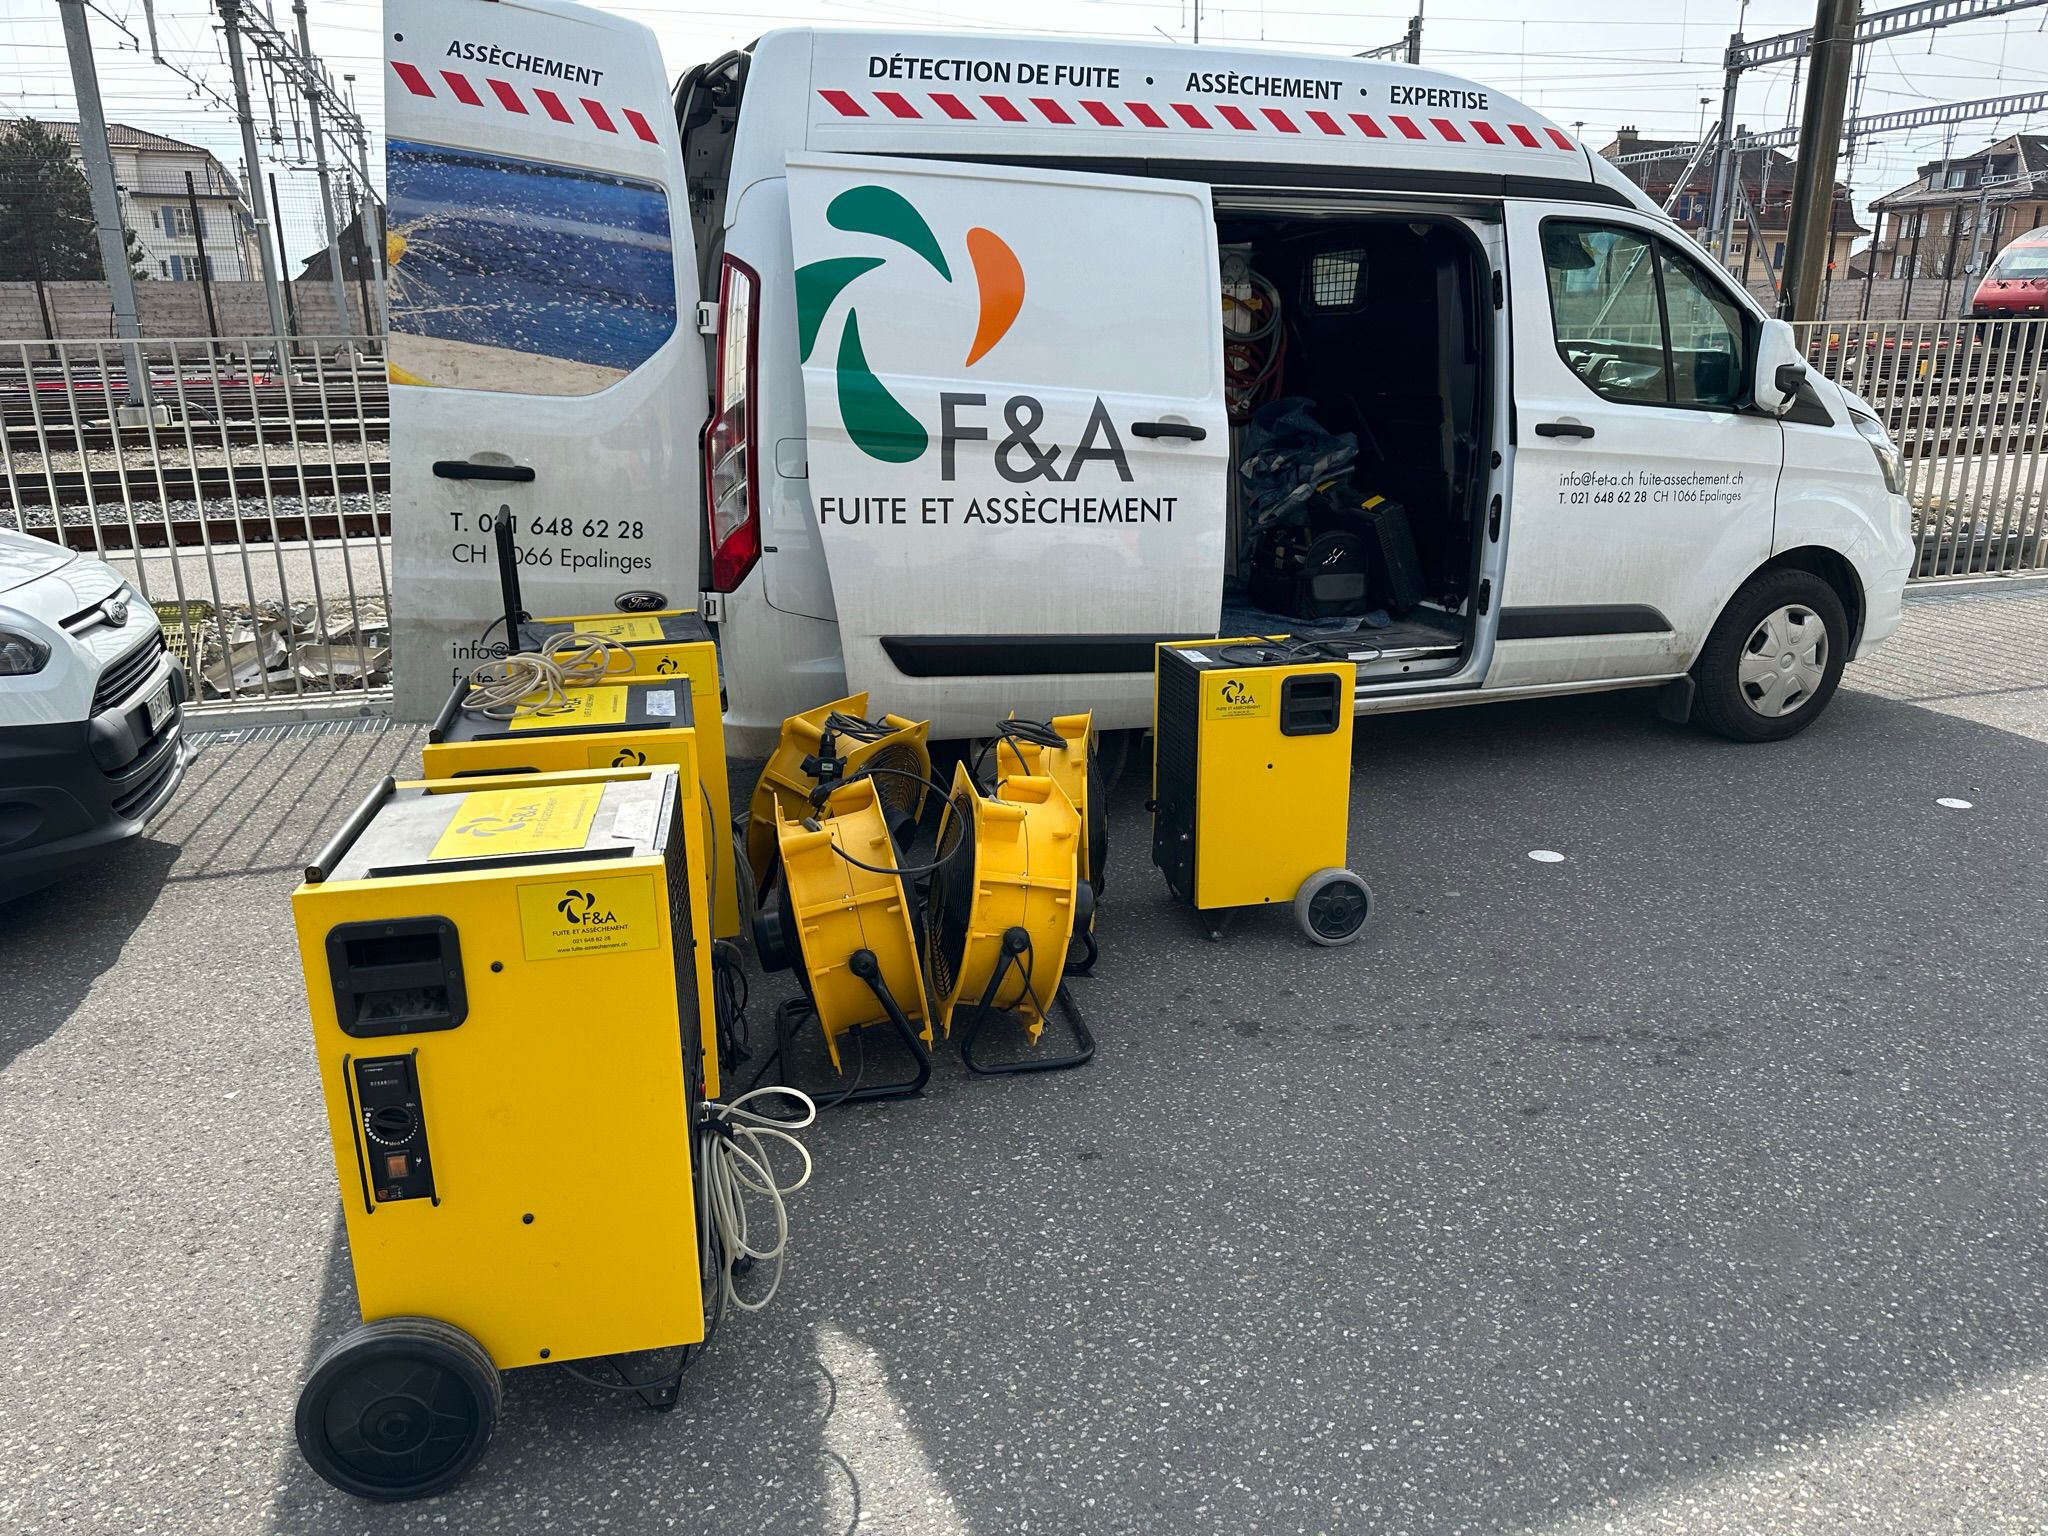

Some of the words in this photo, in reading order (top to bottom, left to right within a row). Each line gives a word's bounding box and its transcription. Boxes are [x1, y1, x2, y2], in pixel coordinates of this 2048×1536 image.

[446, 40, 604, 87] ASSÈCHEMENT
[869, 53, 1011, 83] DÉTECTION
[1017, 63, 1049, 86] DE
[1054, 65, 1120, 88] FUITE
[1186, 71, 1343, 101] ASSÈCHEMENT
[1390, 85, 1489, 110] EXPERTISE
[939, 392, 1134, 483] F&A
[1559, 471, 1634, 487] info@f-et-a.ch
[1639, 471, 1744, 487] fuite-assechement.ch
[820, 497, 906, 524] FUITE
[921, 498, 954, 524] ET
[963, 491, 1178, 524] ASSÈCHEMENT
[1559, 492, 1567, 504] T.
[1571, 492, 1589, 504] 021
[1594, 492, 1614, 504] 648
[1617, 491, 1630, 503] 62
[1634, 491, 1647, 503] 28
[1653, 490, 1668, 502] CH
[1674, 490, 1697, 502] 1066
[1700, 490, 1742, 504] Epalinges
[450, 512, 468, 532] T.
[479, 513, 517, 534] 01
[531, 516, 573, 537] 648
[582, 519, 609, 538] 62
[617, 520, 644, 539] 28
[452, 543, 486, 563] CH
[512, 546, 553, 566] 066
[561, 548, 652, 574] Epalinges
[1234, 695, 1255, 705] F&A
[582, 911, 617, 926] F&A
[552, 929, 570, 937] FUITE
